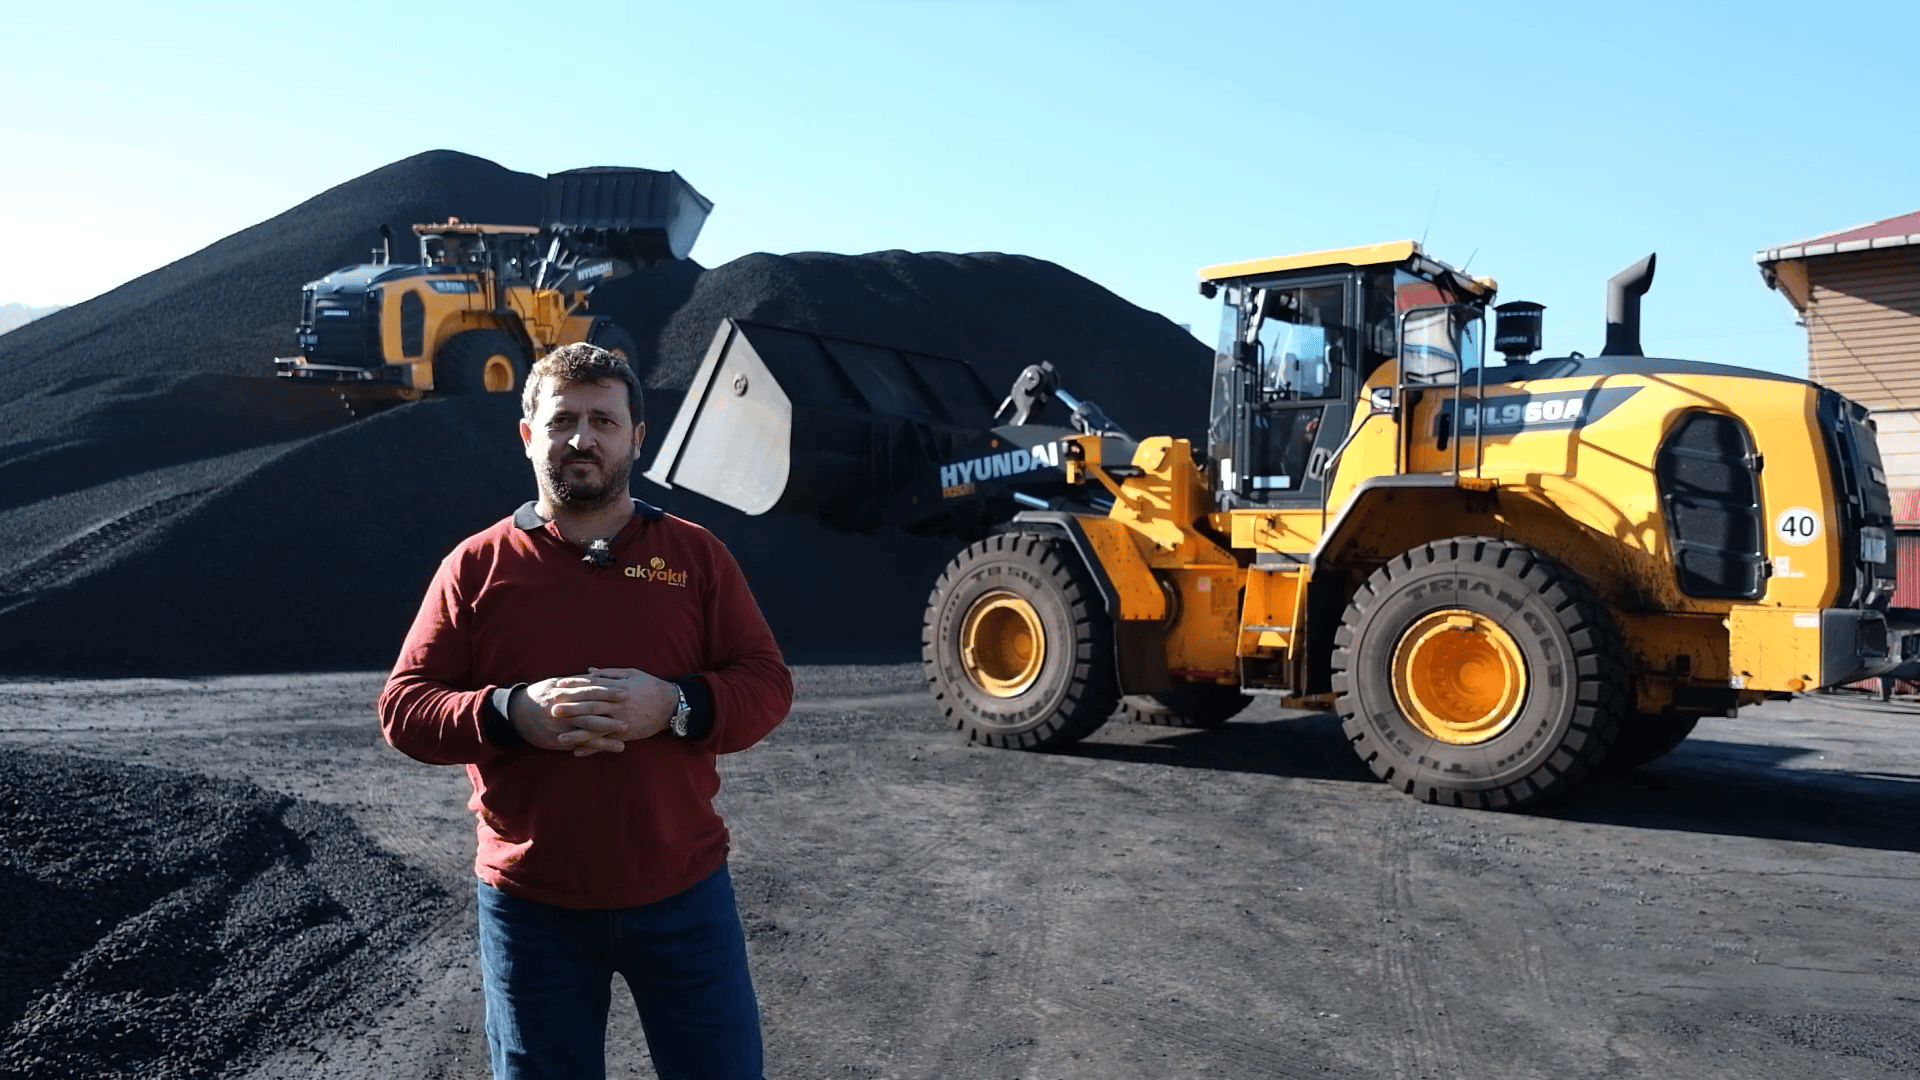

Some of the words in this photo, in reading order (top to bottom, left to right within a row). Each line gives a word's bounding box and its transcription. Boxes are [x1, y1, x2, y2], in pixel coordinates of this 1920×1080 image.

[1464, 398, 1584, 426] HL960A
[940, 441, 1059, 487] HYUNDAI
[1781, 515, 1815, 537] 40
